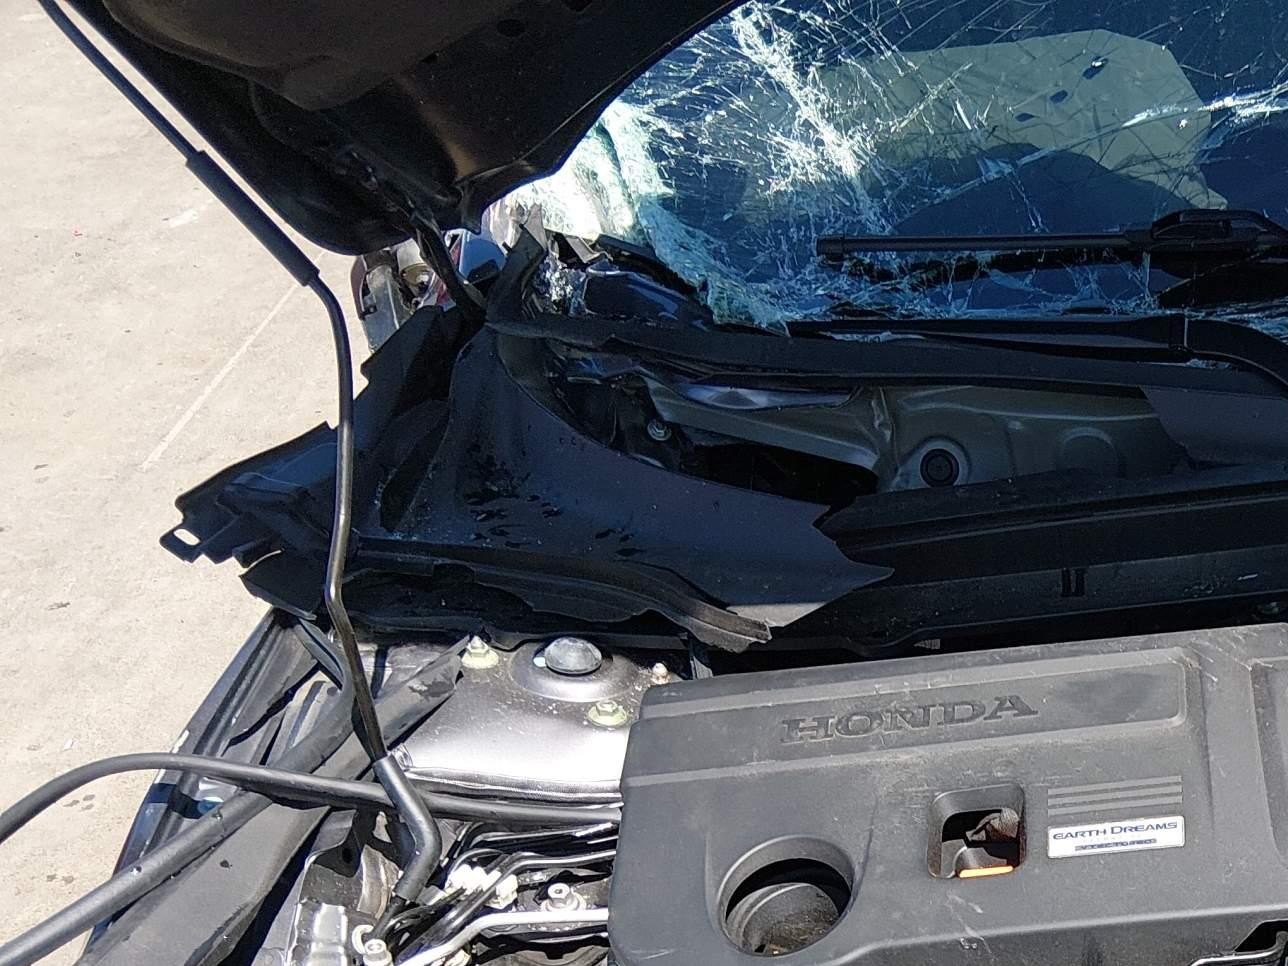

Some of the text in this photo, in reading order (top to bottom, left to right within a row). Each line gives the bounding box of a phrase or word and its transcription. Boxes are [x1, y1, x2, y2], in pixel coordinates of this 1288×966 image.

[781, 694, 1039, 744] HONDA
[1052, 821, 1178, 840] EARTH DREAMS
